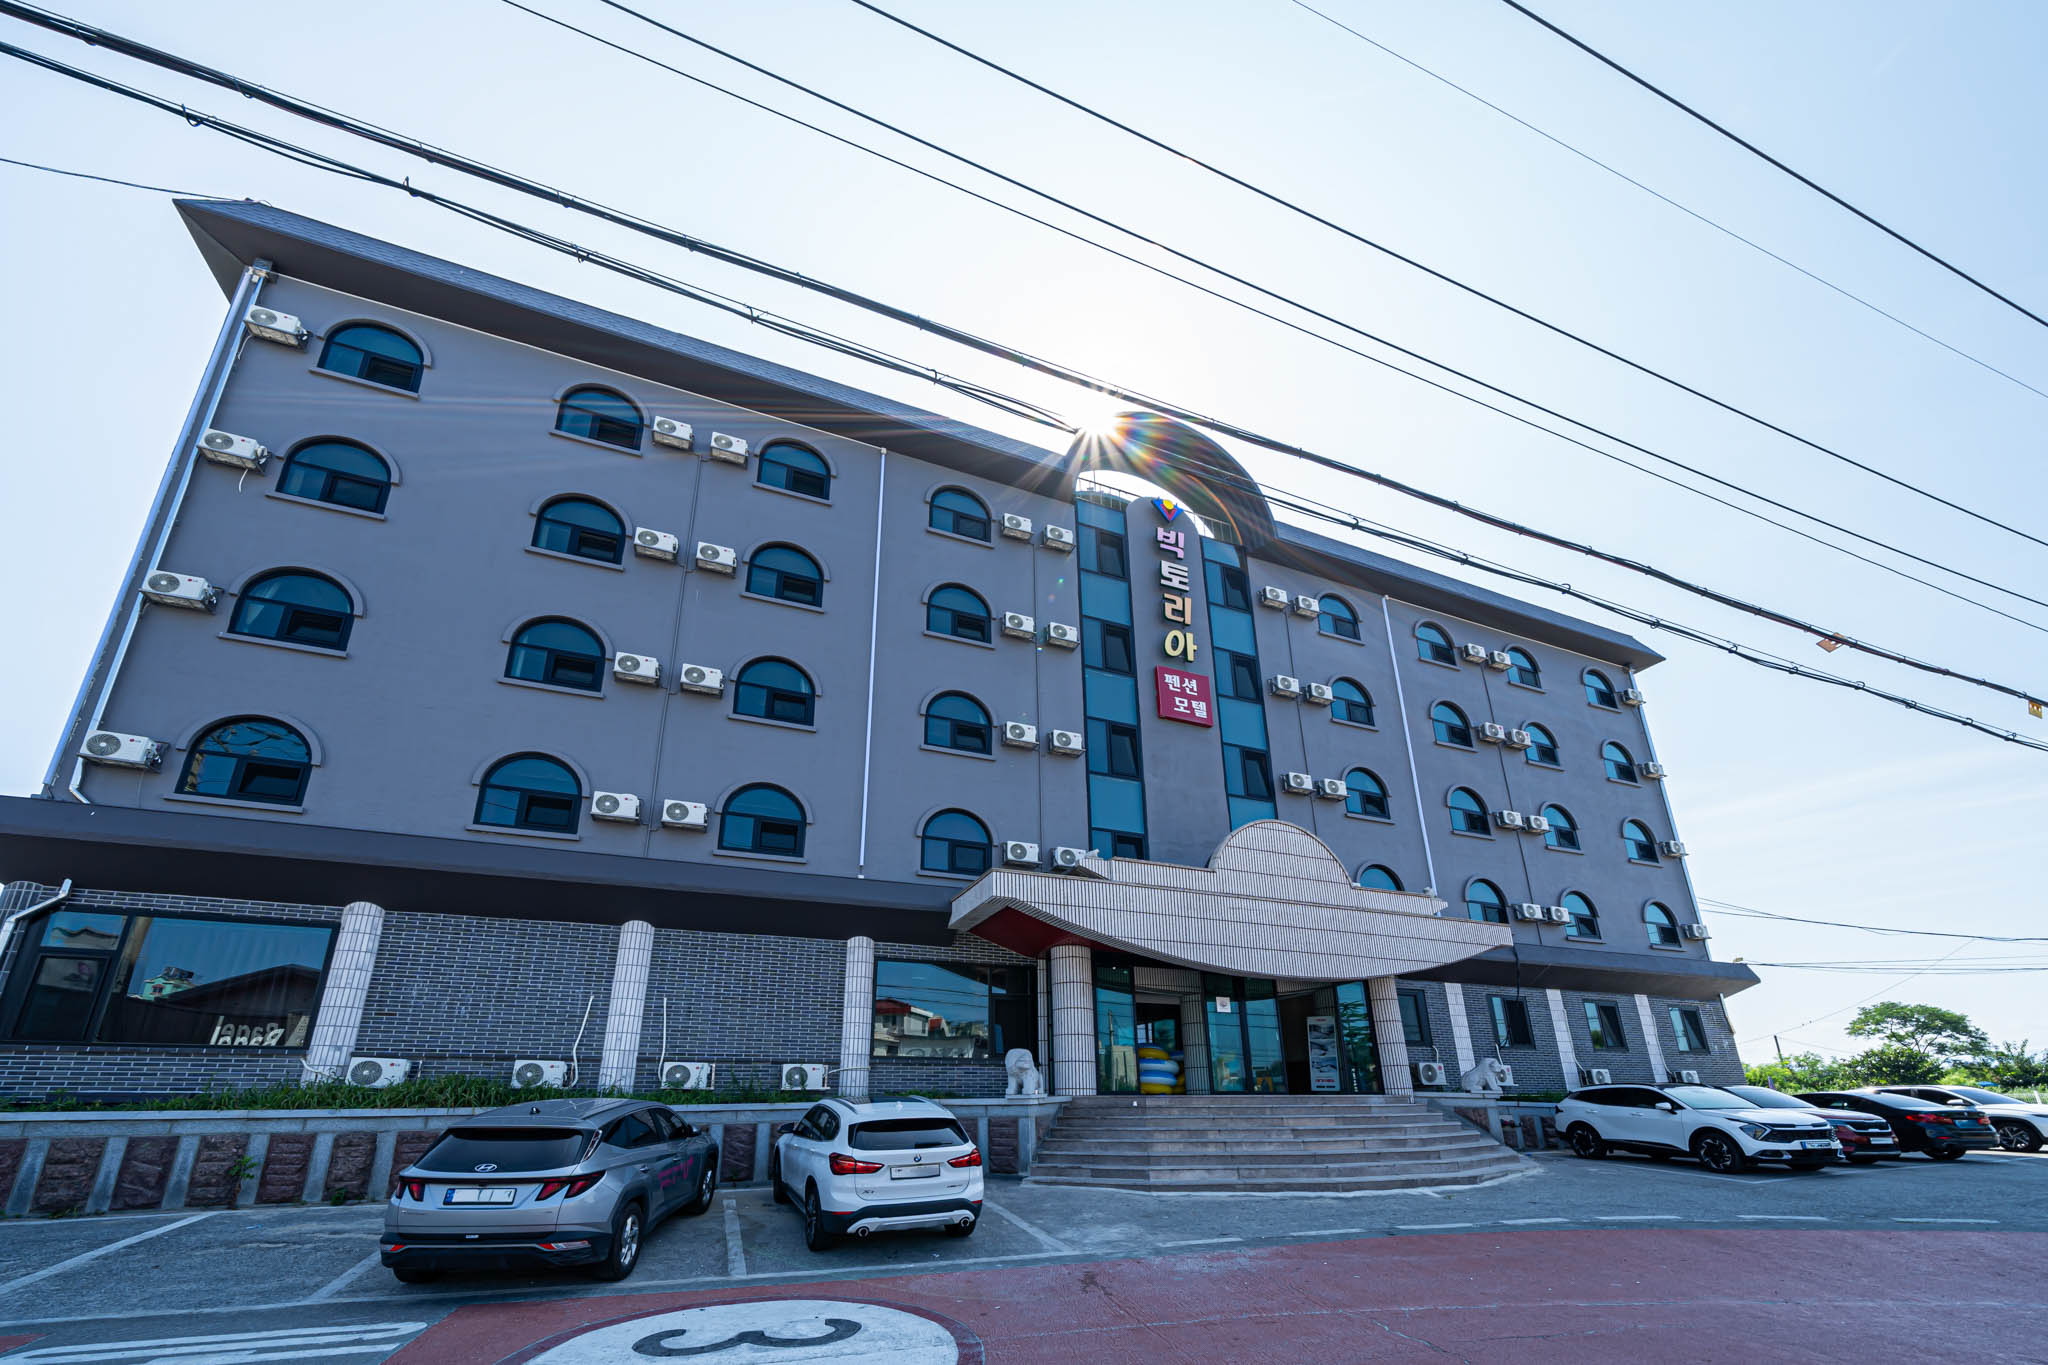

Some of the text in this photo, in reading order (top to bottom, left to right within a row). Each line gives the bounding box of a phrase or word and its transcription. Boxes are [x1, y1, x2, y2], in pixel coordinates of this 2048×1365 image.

[1156, 527, 1197, 662] 빅토리아
[1165, 673, 1198, 696] 펜션
[1175, 696, 1207, 719] 모텔
